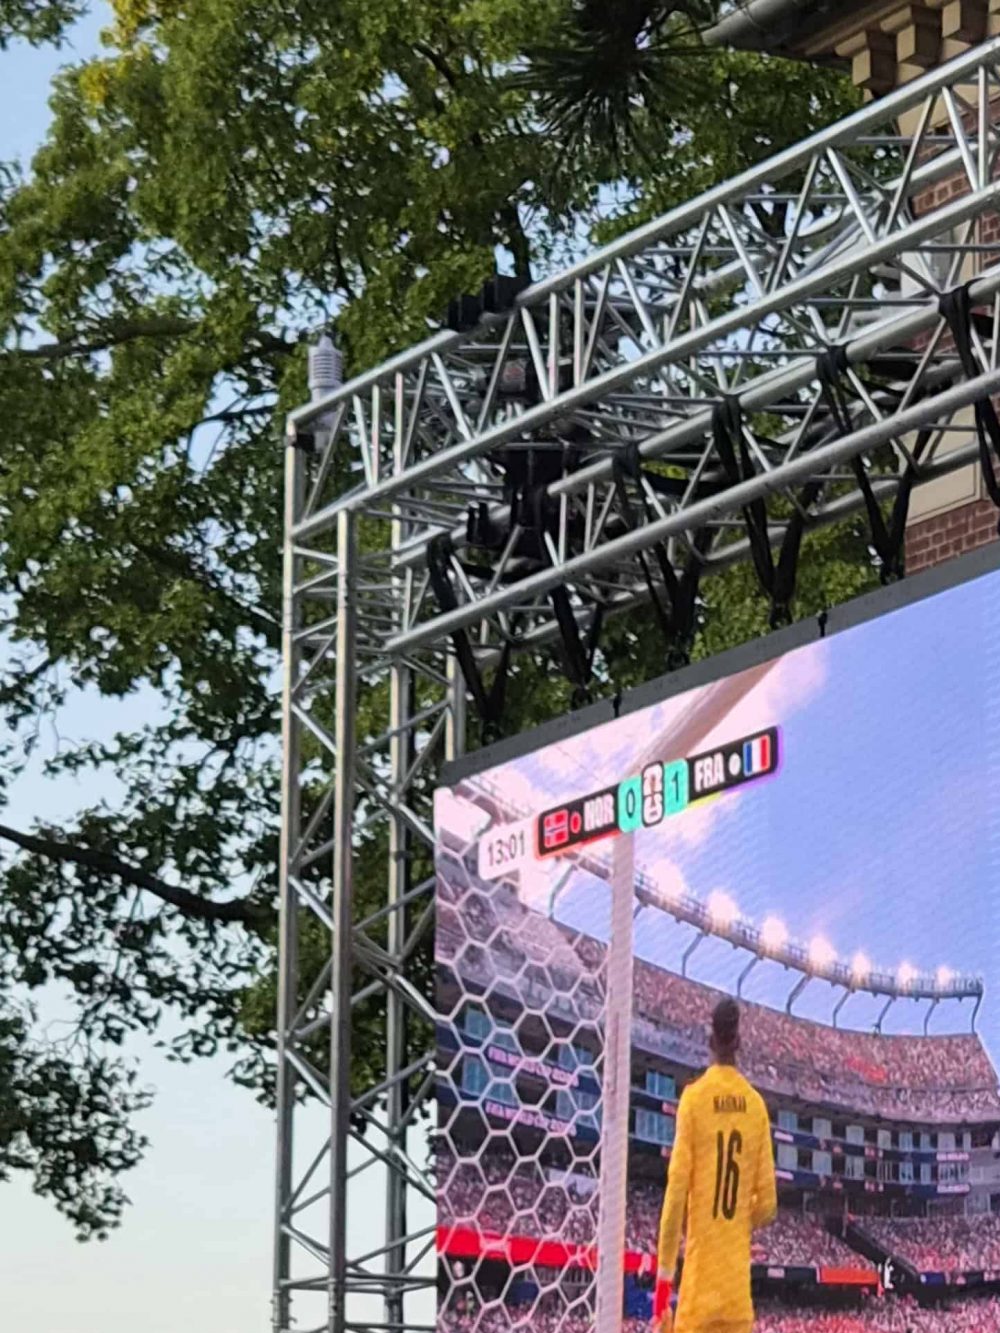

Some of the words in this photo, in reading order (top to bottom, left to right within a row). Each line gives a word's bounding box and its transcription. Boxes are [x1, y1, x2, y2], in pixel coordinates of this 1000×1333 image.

[671, 770, 680, 803] 1
[694, 752, 726, 792] FRA
[712, 1129, 743, 1220] 16
